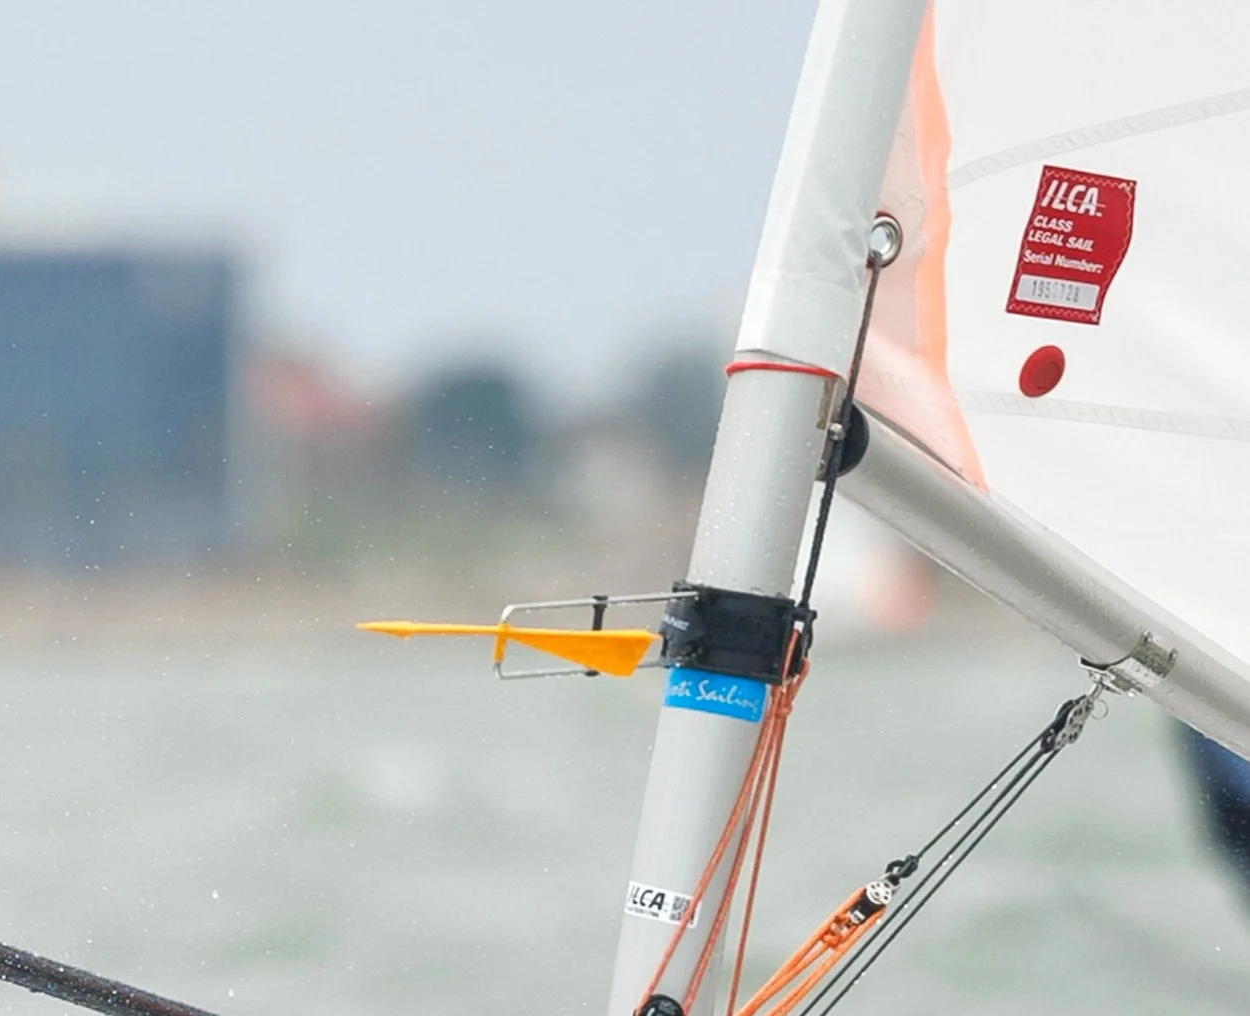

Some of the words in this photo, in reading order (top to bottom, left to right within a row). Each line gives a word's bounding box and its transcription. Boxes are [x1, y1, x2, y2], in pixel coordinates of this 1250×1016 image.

[1033, 214, 1073, 233] CLASS
[1027, 229, 1064, 247] LEGAL
[1065, 236, 1094, 253] SAIL
[1022, 249, 1054, 266] Serial
[1054, 254, 1104, 274] Number:
